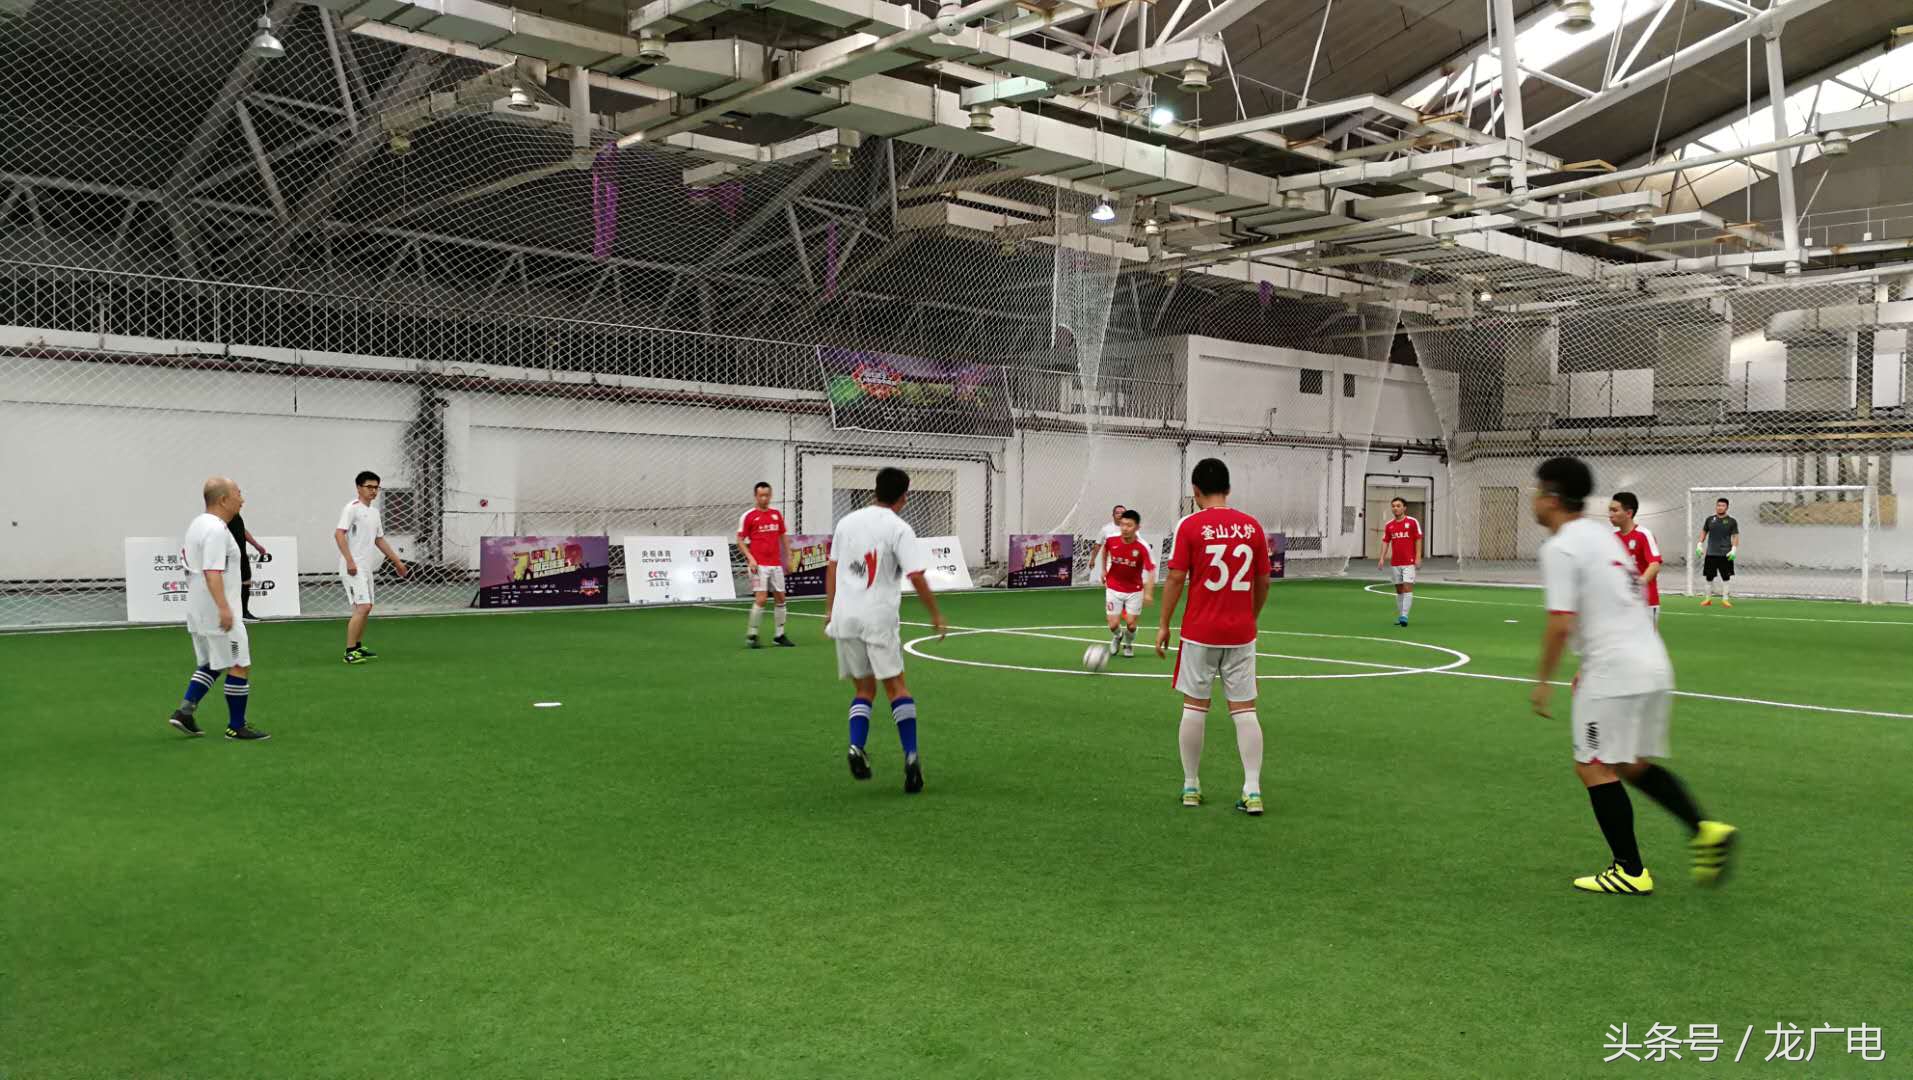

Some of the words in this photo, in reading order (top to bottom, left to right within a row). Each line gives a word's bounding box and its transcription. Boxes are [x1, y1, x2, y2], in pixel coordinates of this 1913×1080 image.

[1201, 523, 1256, 540] 釜山火炉
[1204, 544, 1254, 591] 32
